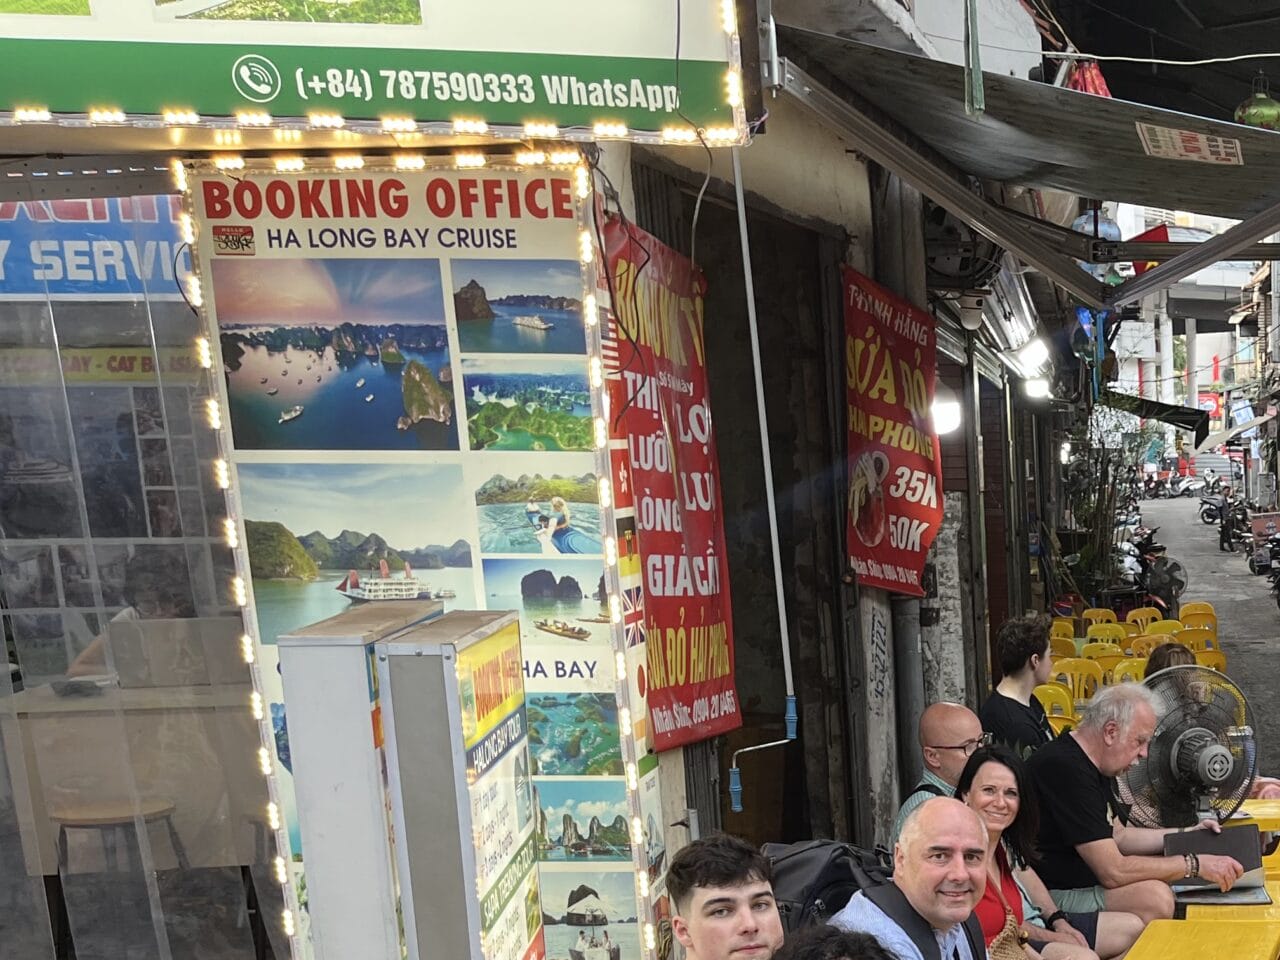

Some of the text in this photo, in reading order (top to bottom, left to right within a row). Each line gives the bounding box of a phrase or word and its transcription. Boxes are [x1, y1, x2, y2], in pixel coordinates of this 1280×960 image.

[295, 68, 678, 112] (+84) 787590333 WhatsApp
[202, 178, 409, 219] BOOKING
[426, 178, 574, 219] OFFICE
[267, 228, 301, 249] HA
[309, 227, 378, 249] LONG
[385, 227, 430, 248] BAY
[437, 227, 518, 249] CRUISE
[889, 515, 930, 552] 50K
[555, 661, 597, 678] BAY
